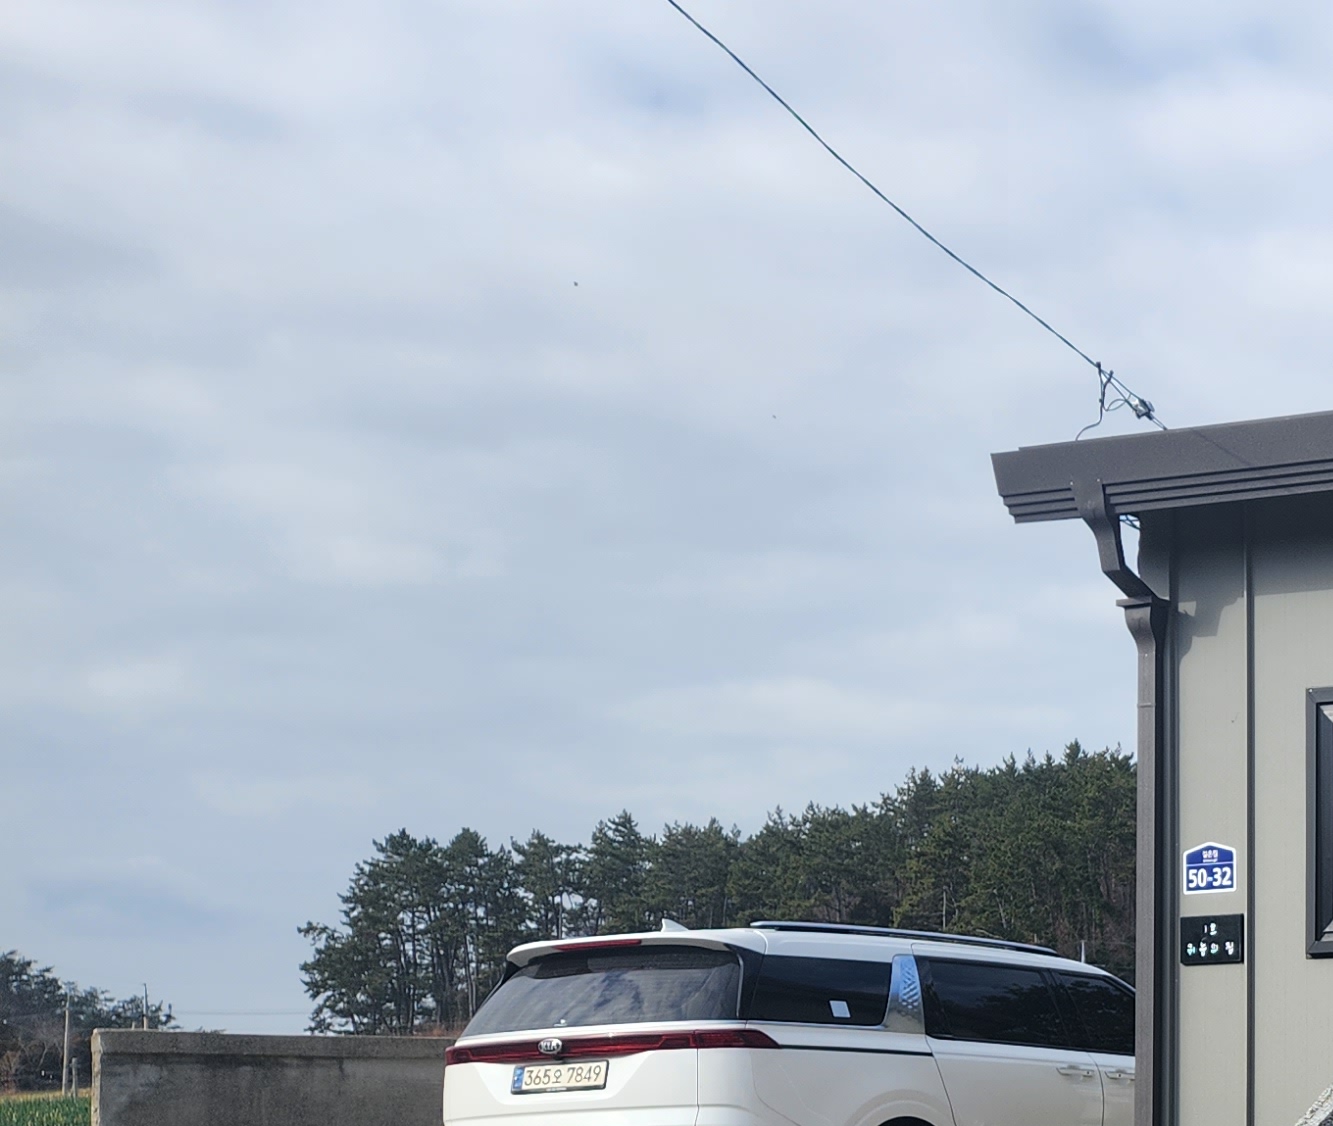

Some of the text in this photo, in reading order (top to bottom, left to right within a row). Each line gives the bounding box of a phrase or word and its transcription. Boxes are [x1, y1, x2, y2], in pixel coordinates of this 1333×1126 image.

[1188, 867, 1232, 888] 50-32
[1186, 941, 1234, 957] 귀농의 집
[524, 1065, 602, 1086] 365오 7849
